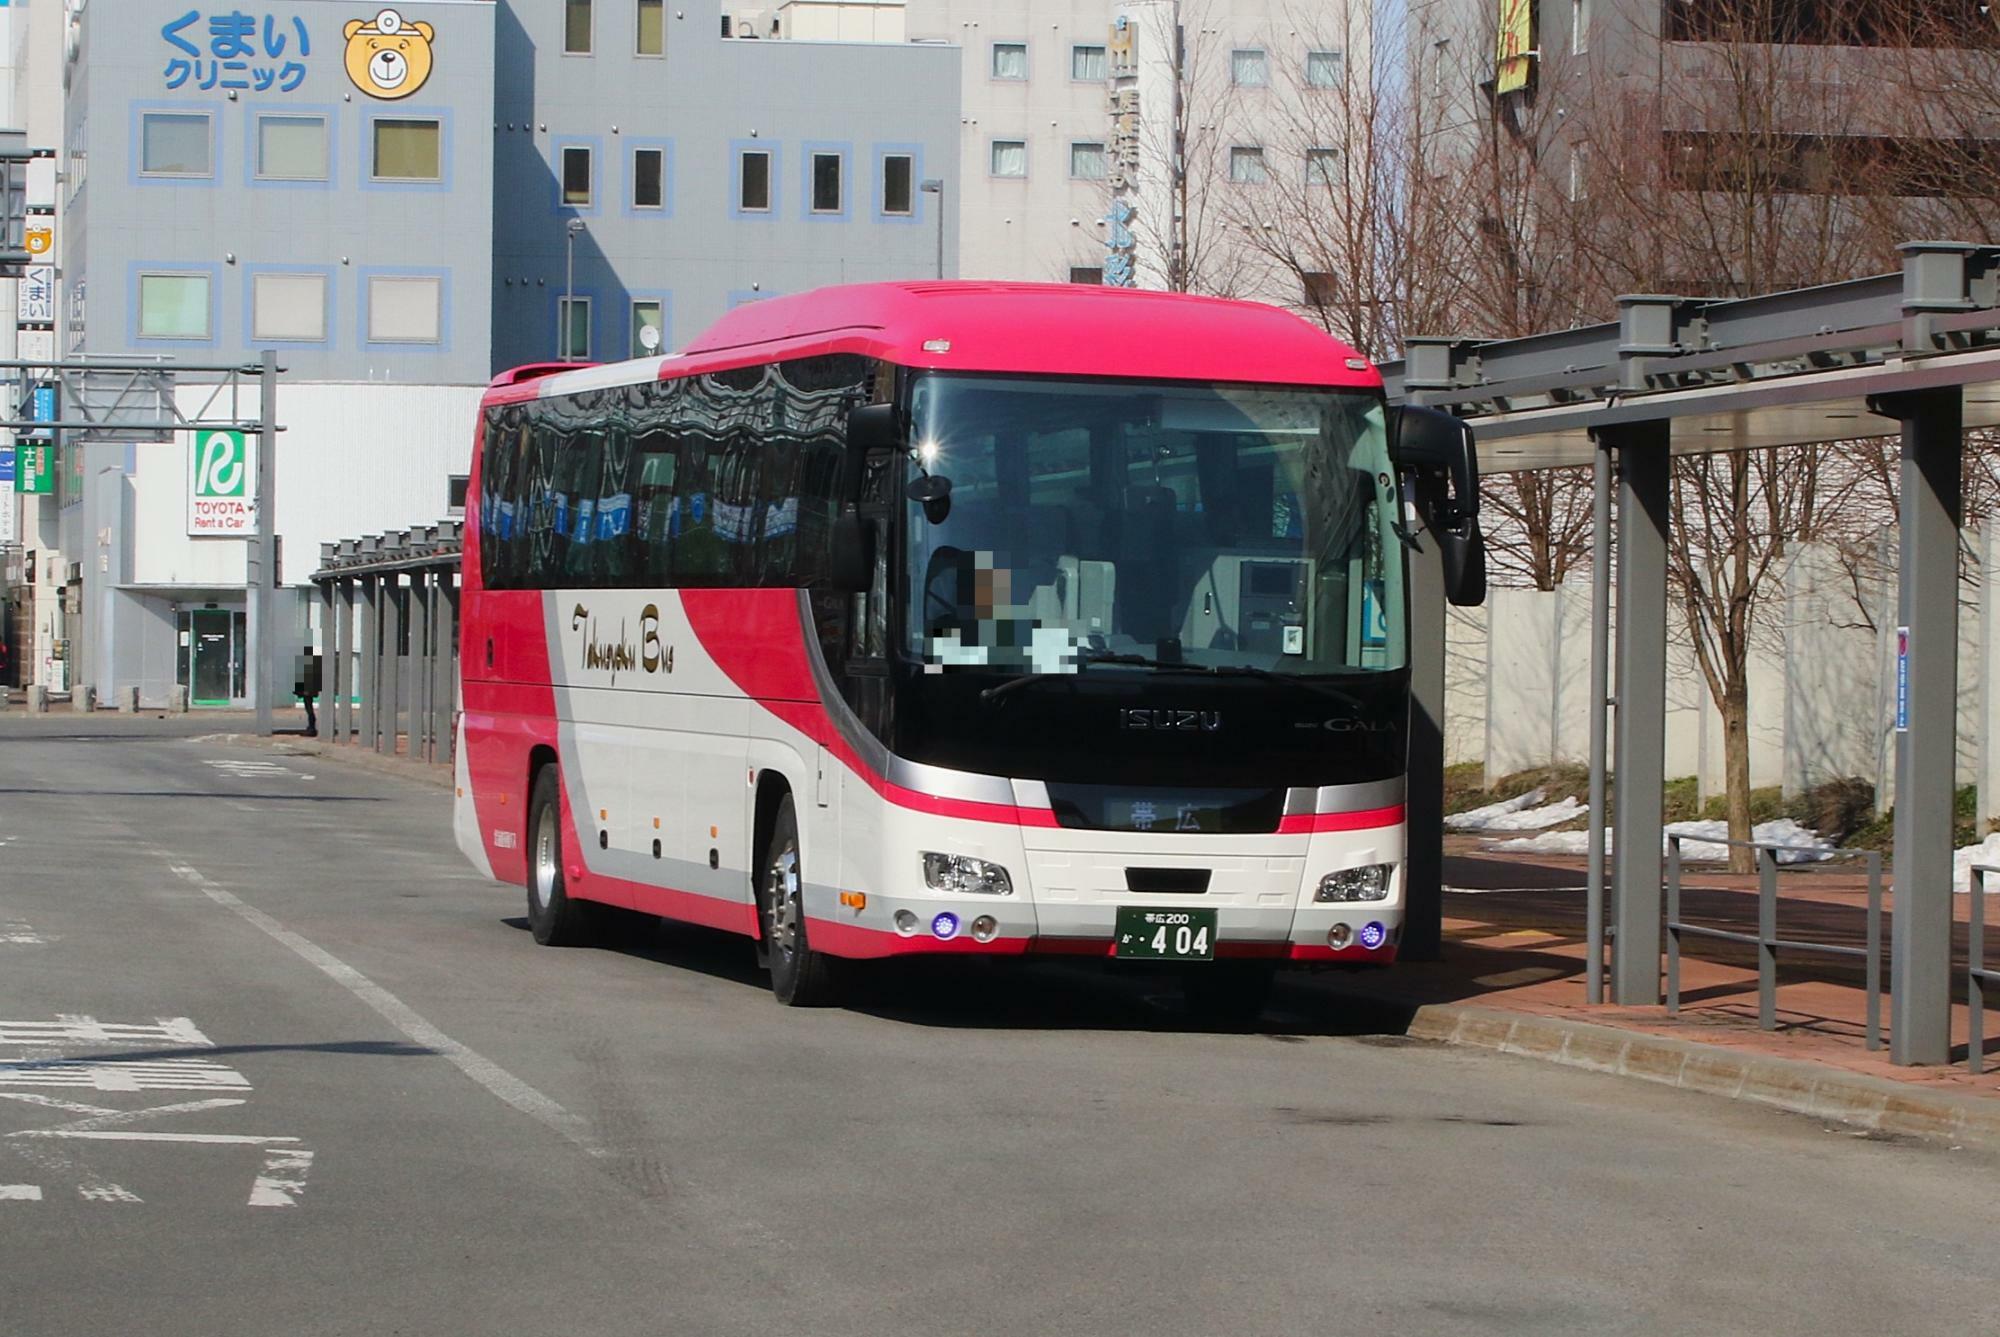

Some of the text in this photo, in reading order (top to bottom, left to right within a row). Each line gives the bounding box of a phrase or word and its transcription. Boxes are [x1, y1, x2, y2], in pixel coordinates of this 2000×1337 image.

[161, 10, 311, 59] くまい
[163, 58, 307, 92] クリニック
[30, 268, 45, 317] くまい
[194, 502, 245, 514] TOYOTA
[194, 517, 245, 528] Rent a Car
[641, 603, 674, 675] Bus
[1120, 708, 1221, 730] ISUZU
[1323, 718, 1398, 732] GALA
